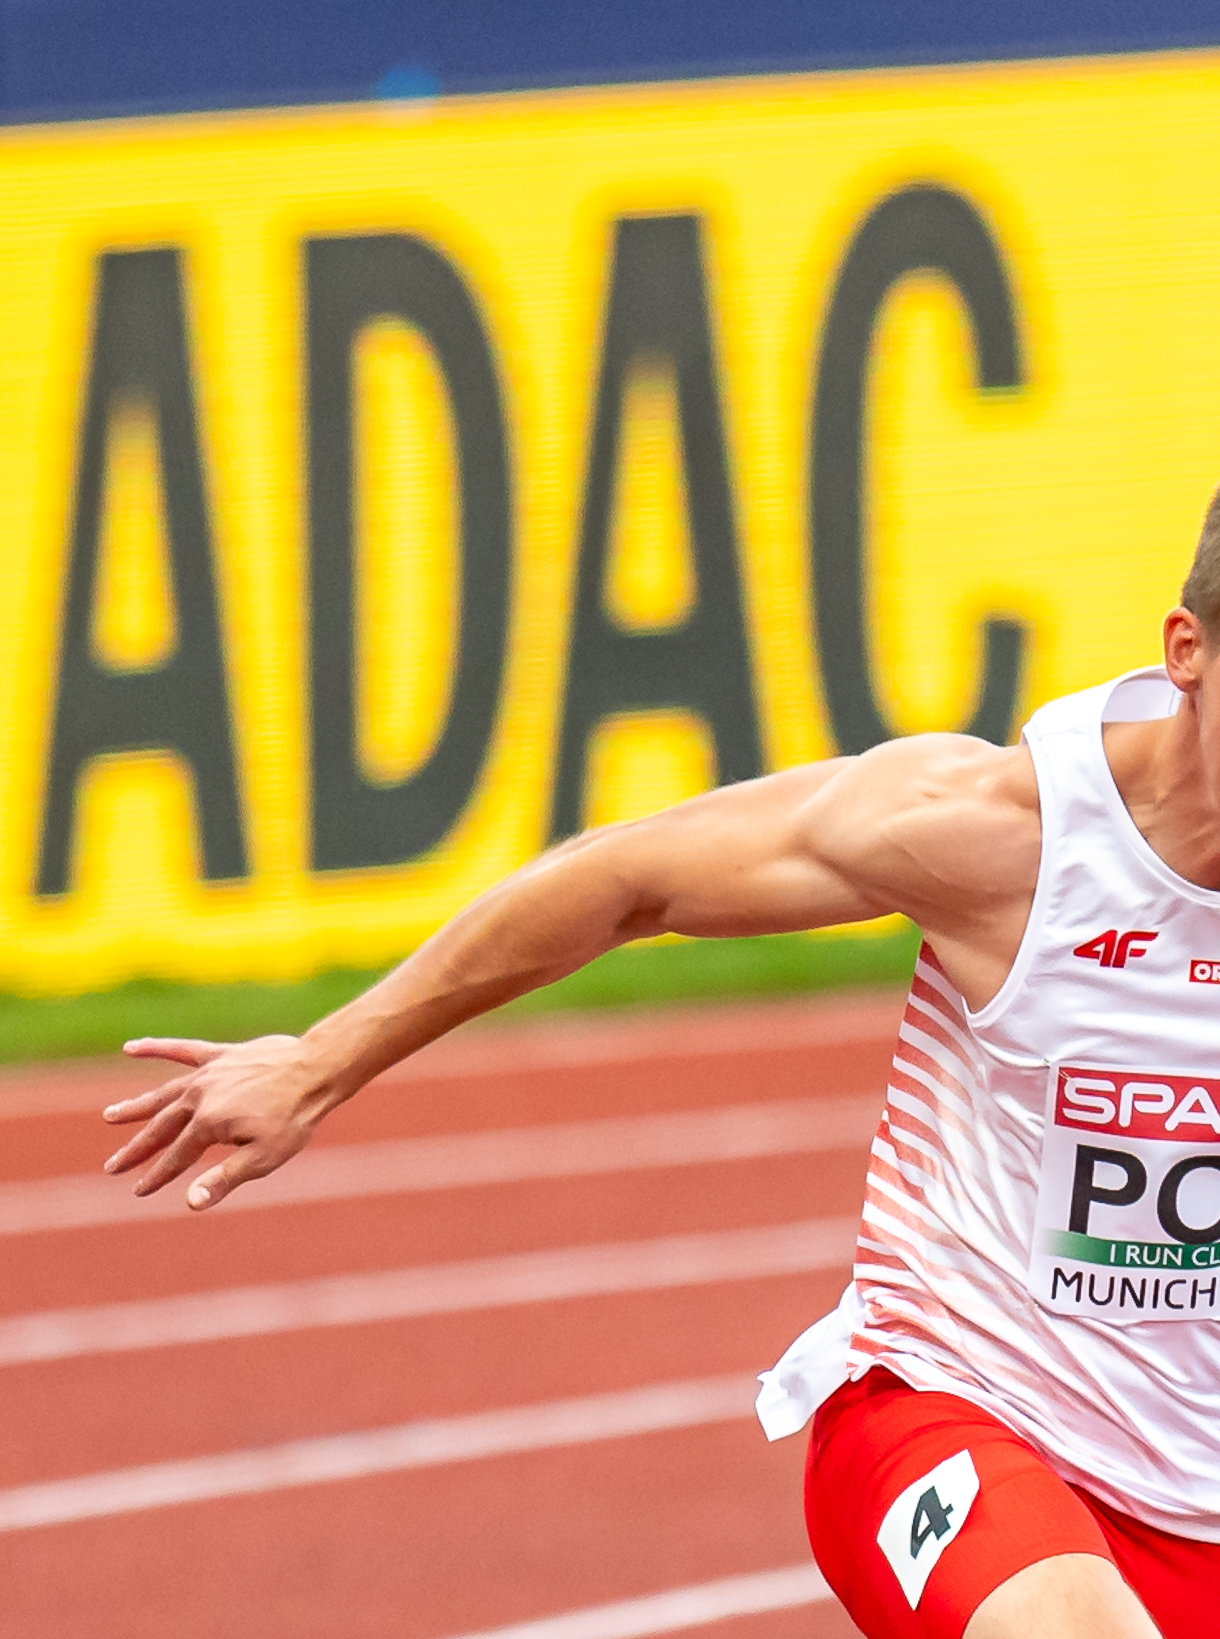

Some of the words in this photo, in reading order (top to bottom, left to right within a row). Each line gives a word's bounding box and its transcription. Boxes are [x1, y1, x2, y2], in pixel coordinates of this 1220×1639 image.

[34, 180, 1028, 897] ADAC
[1073, 929, 1159, 968] 4F
[1109, 1243, 1117, 1263] I
[1126, 1244, 1183, 1267] RUN
[1051, 1266, 1217, 1309] MUNICH
[910, 1485, 954, 1560] 4
